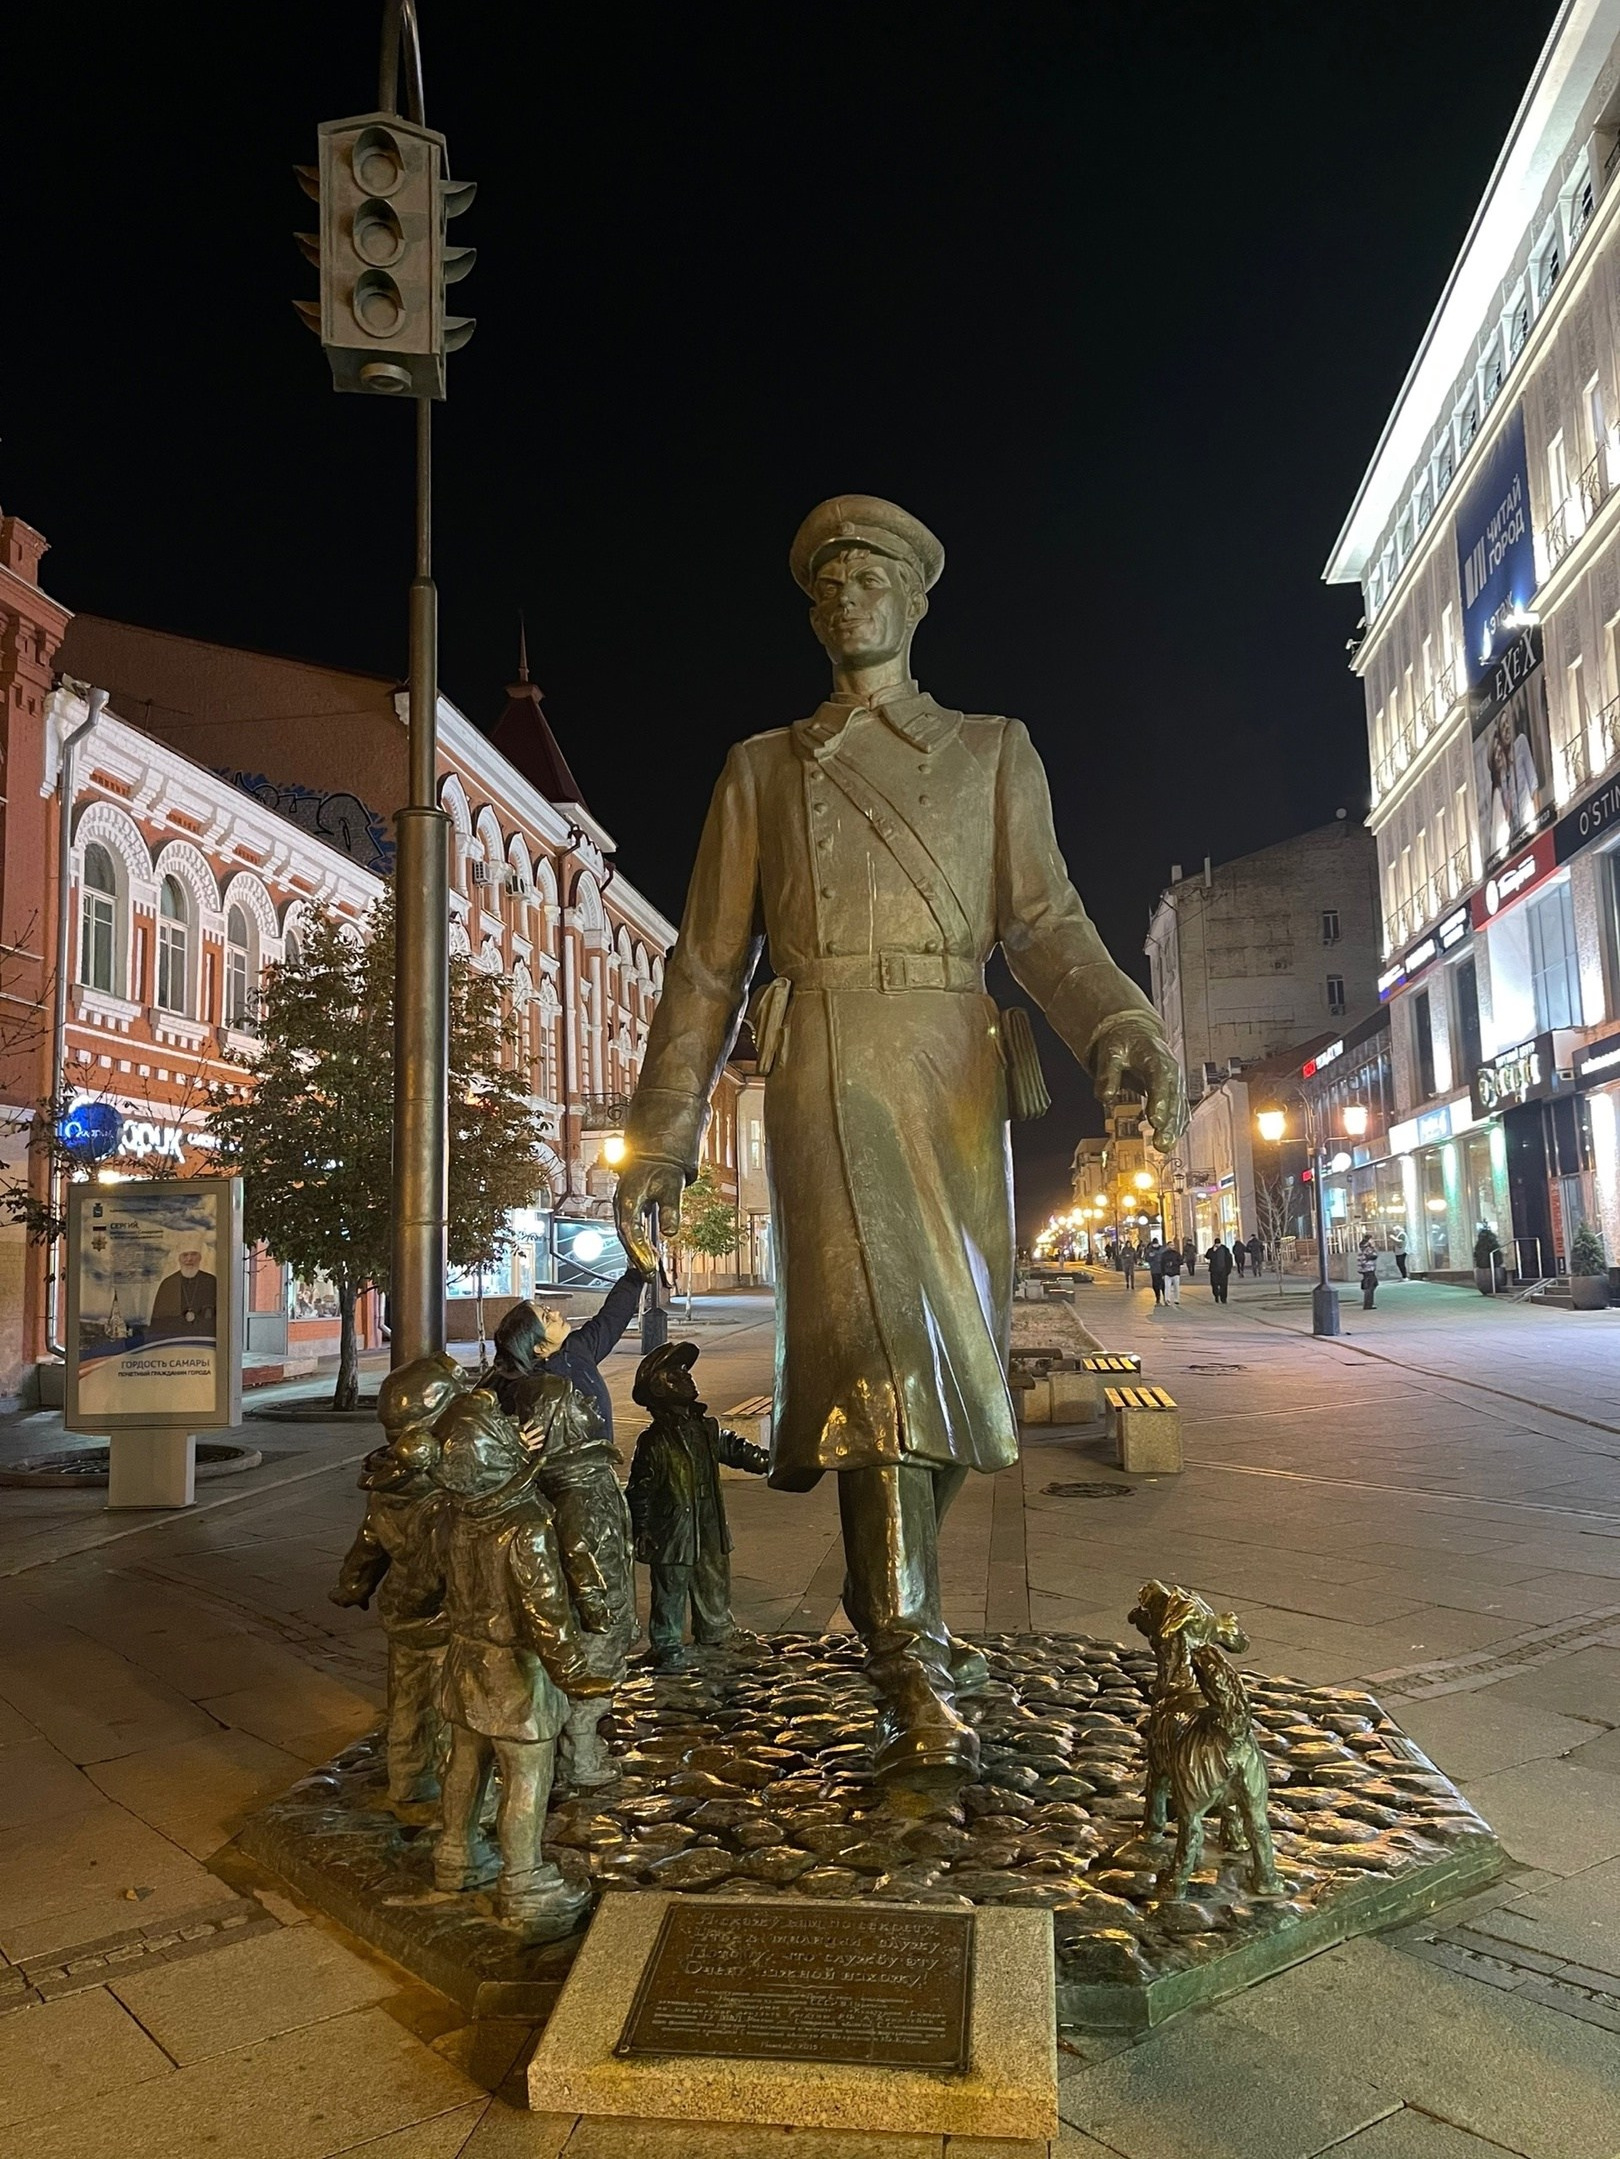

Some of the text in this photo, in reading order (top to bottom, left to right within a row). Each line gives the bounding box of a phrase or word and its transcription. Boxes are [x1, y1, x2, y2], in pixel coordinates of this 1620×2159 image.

[1487, 473, 1521, 542] ЧИТАЙ
[1489, 507, 1524, 575] ГОРОД
[121, 1359, 210, 1369] ГОРДОСТЬ САМАРЫ
